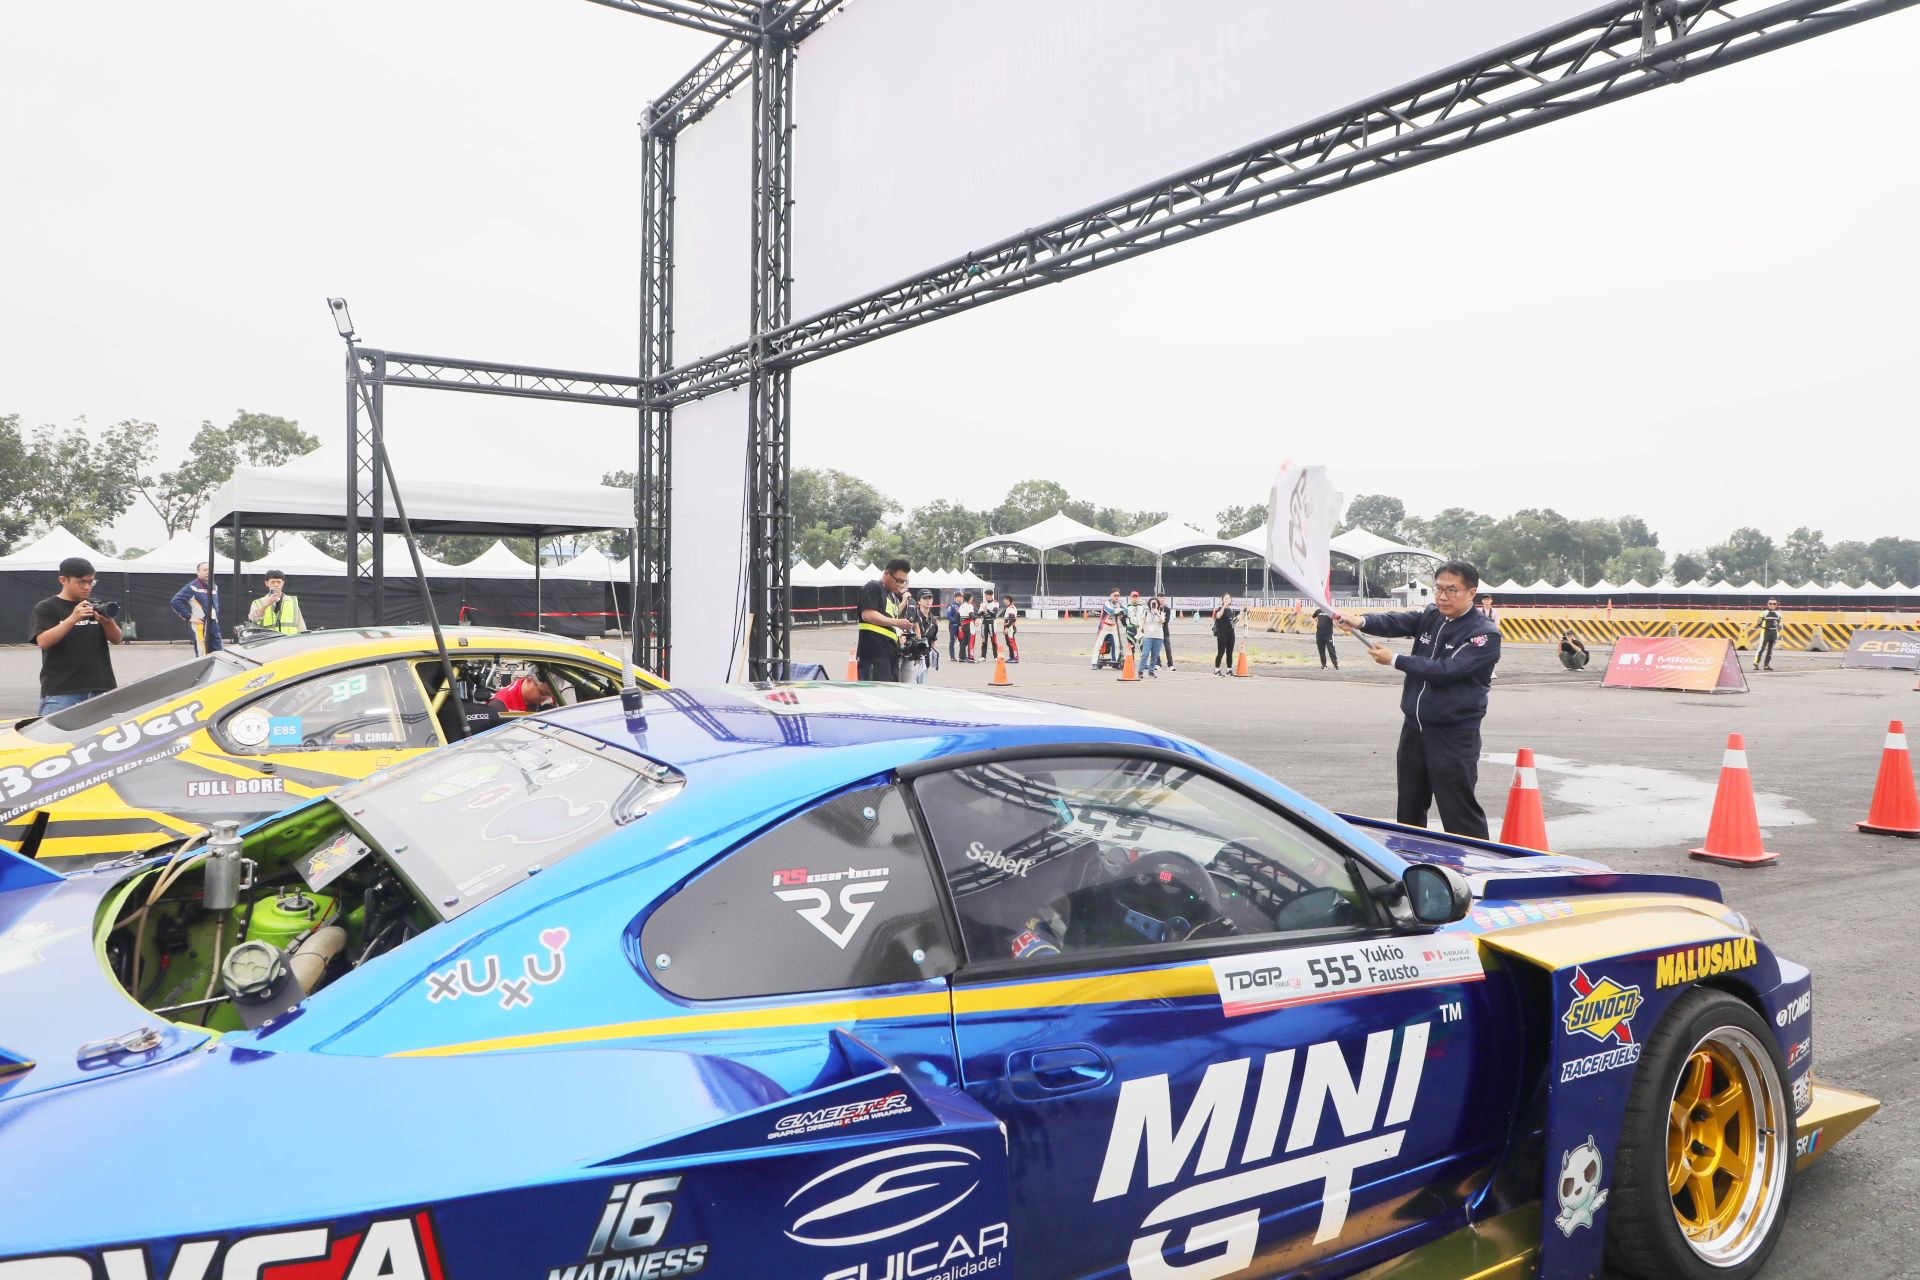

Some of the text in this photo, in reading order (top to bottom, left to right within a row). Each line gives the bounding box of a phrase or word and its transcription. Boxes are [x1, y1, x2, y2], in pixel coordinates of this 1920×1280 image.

[1657, 656, 1714, 665] MIRAGE
[1856, 640, 1901, 653] BC
[273, 725, 296, 736] E85
[354, 732, 394, 743] B. CIRBA
[0, 743, 190, 823] HIGH PERFORMANCE BEST QUALITY
[187, 777, 284, 799] FULL BORE
[965, 841, 1034, 878] Sabelt
[1359, 944, 1404, 963] Yukio
[1655, 937, 1757, 990] MALUSAKA
[1225, 966, 1283, 991] TDGP
[1306, 954, 1362, 989] 555
[1368, 963, 1420, 984] Fausto
[1570, 992, 1637, 1027] SUNOCO
[1786, 989, 1811, 1025] TOMEI
[1560, 1042, 1642, 1083] RACE FUELS
[1092, 1001, 1463, 1202] MINI TM
[768, 1127, 805, 1139] GRAPHIC
[853, 1114, 869, 1123] CAR
[871, 1106, 912, 1119] WRAPPING
[588, 1175, 683, 1257] i6
[1127, 1129, 1406, 1280] GT
